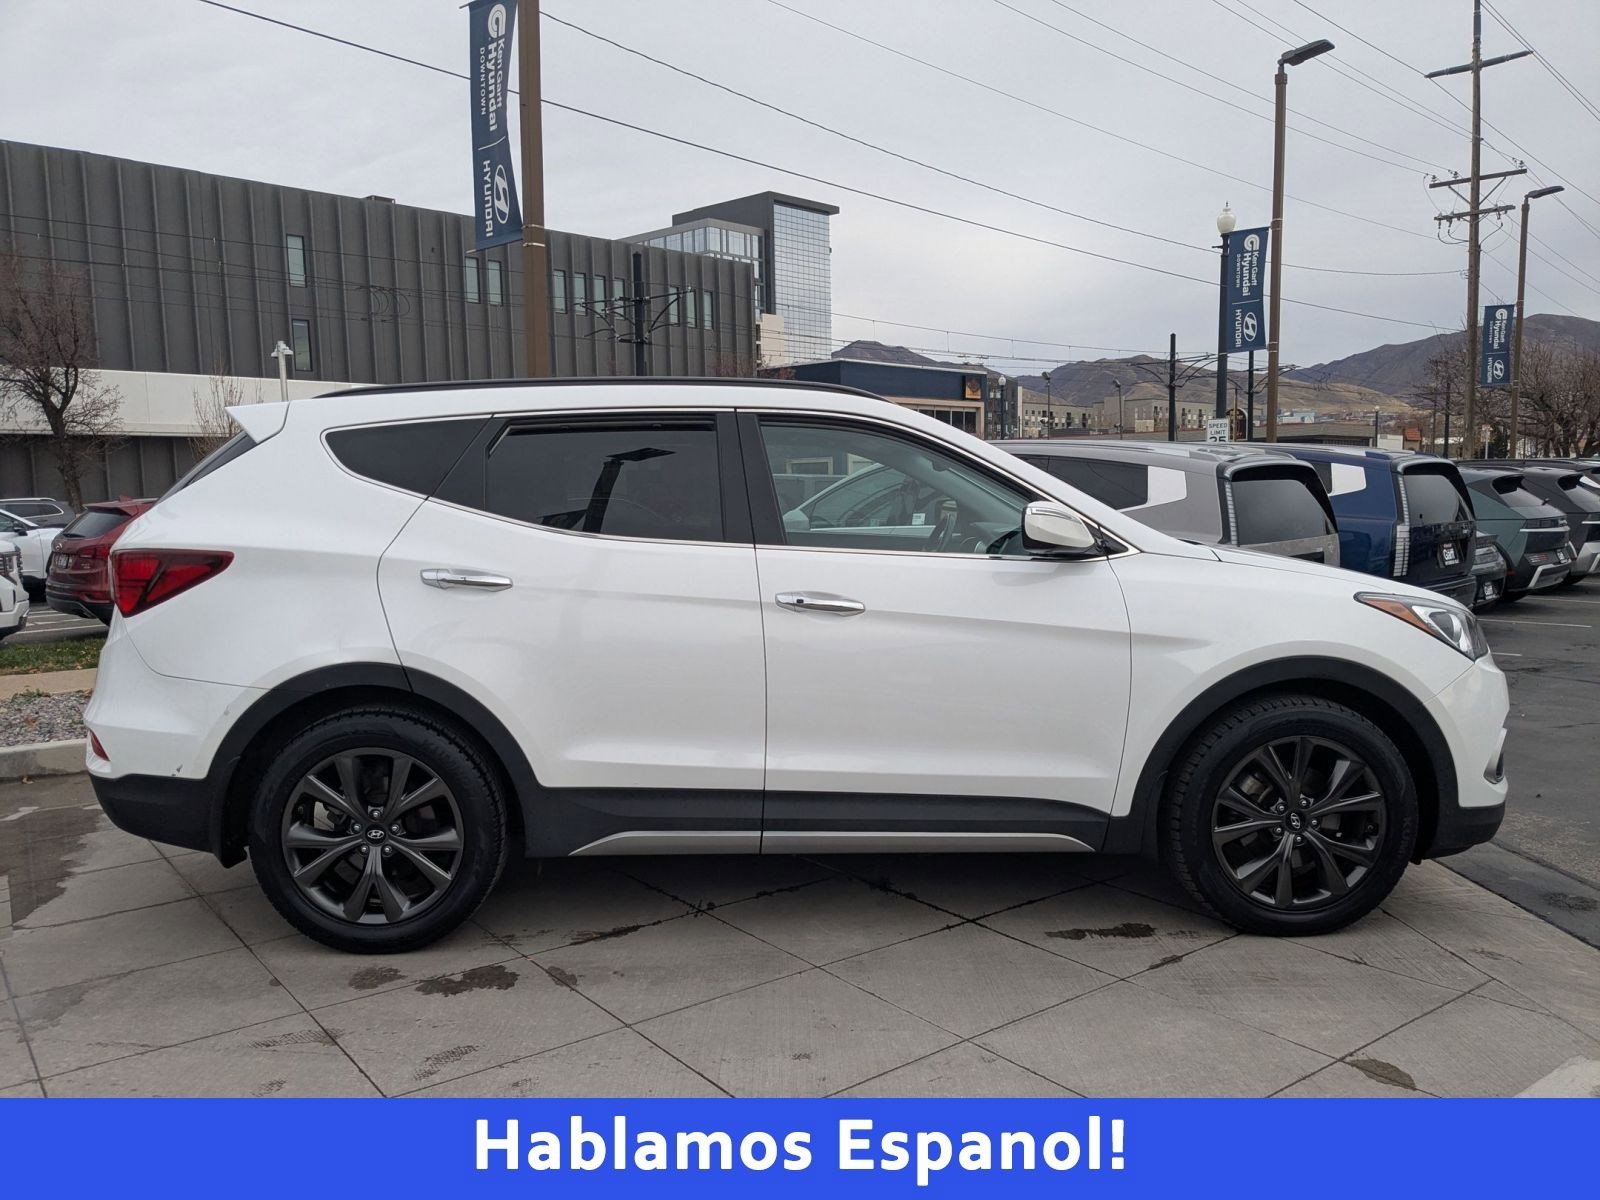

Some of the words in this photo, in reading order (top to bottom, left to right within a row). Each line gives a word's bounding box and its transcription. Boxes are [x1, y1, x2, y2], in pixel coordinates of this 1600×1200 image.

[479, 47, 487, 116] DOWNTOWN
[497, 38, 506, 69] Ken
[487, 41, 498, 132] Hyundai
[482, 160, 494, 238] HYUNDAI
[1242, 252, 1251, 297] Hyundai
[1493, 320, 1502, 349] Hyundai
